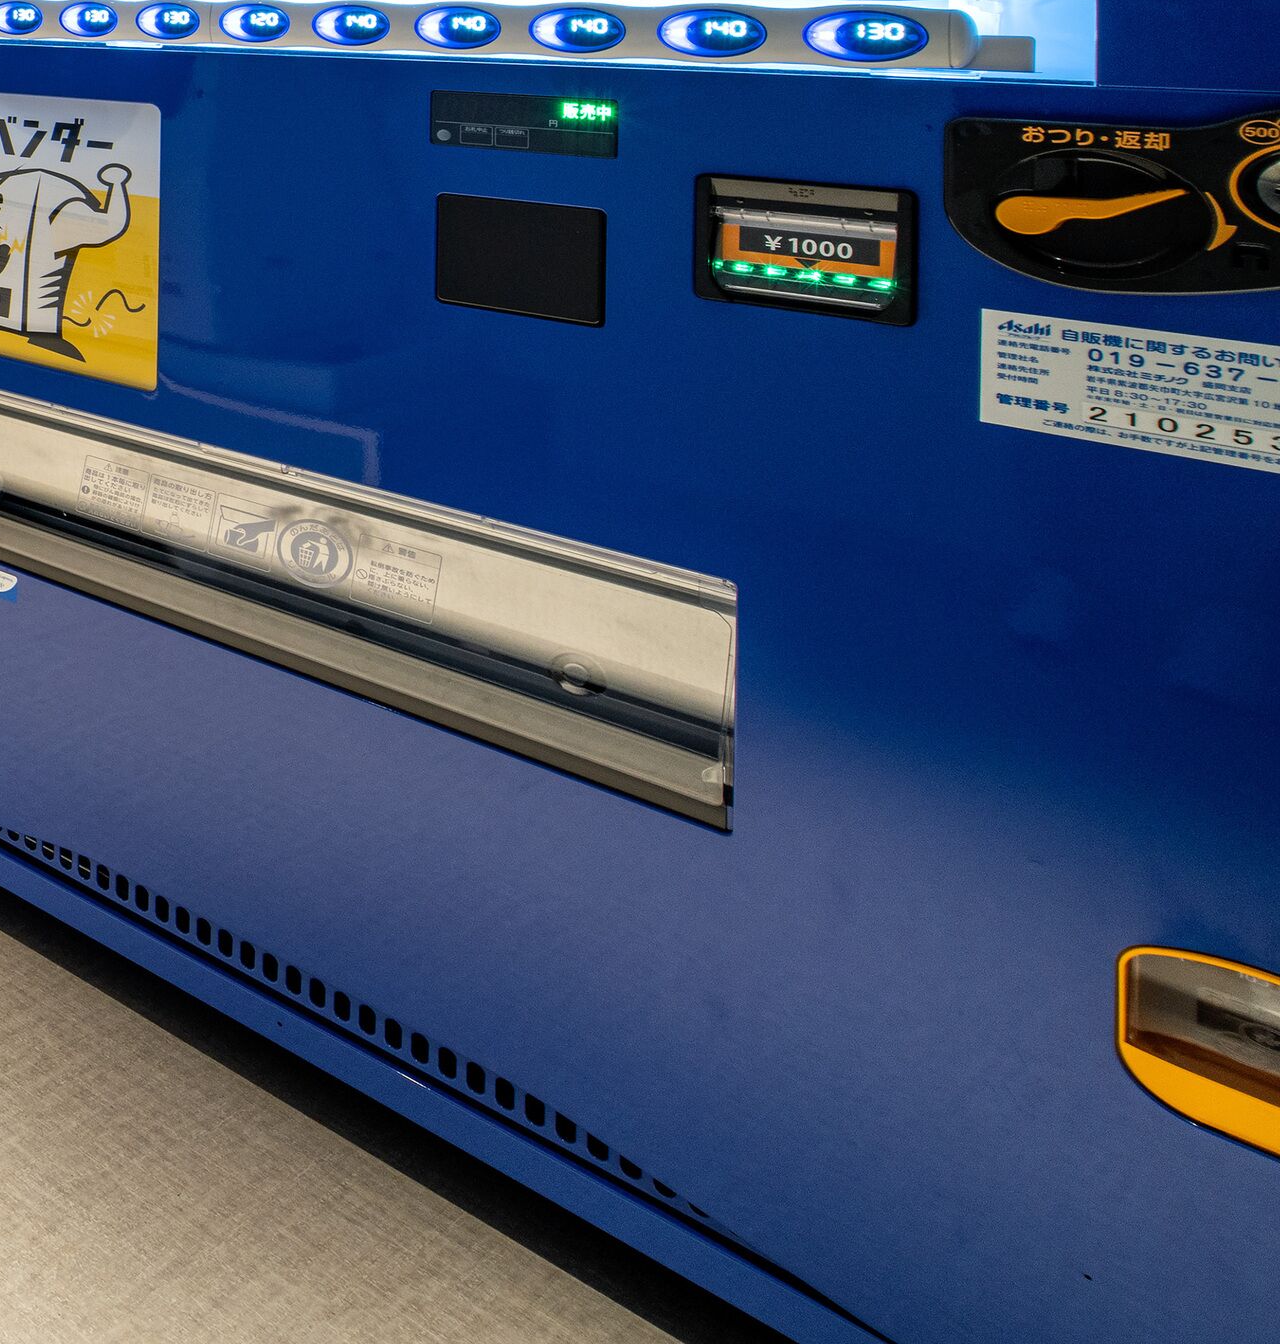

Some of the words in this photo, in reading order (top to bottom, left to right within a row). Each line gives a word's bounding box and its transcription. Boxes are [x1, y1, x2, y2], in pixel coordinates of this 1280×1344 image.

[163, 10, 191, 26] 130
[248, 11, 280, 28] 120
[345, 12, 377, 30] 140
[451, 15, 486, 33] 140
[570, 16, 609, 36] 140
[704, 19, 748, 39] 140
[856, 21, 906, 42] 130
[561, 101, 613, 123] 販売中
[548, 118, 559, 129] 円
[1244, 124, 1279, 139] 500
[1020, 125, 1172, 152] おつり・返却
[997, 318, 1052, 339] Asahi
[1086, 364, 1189, 386] 株式会社ミチノク
[996, 392, 1071, 415] 管理番号
